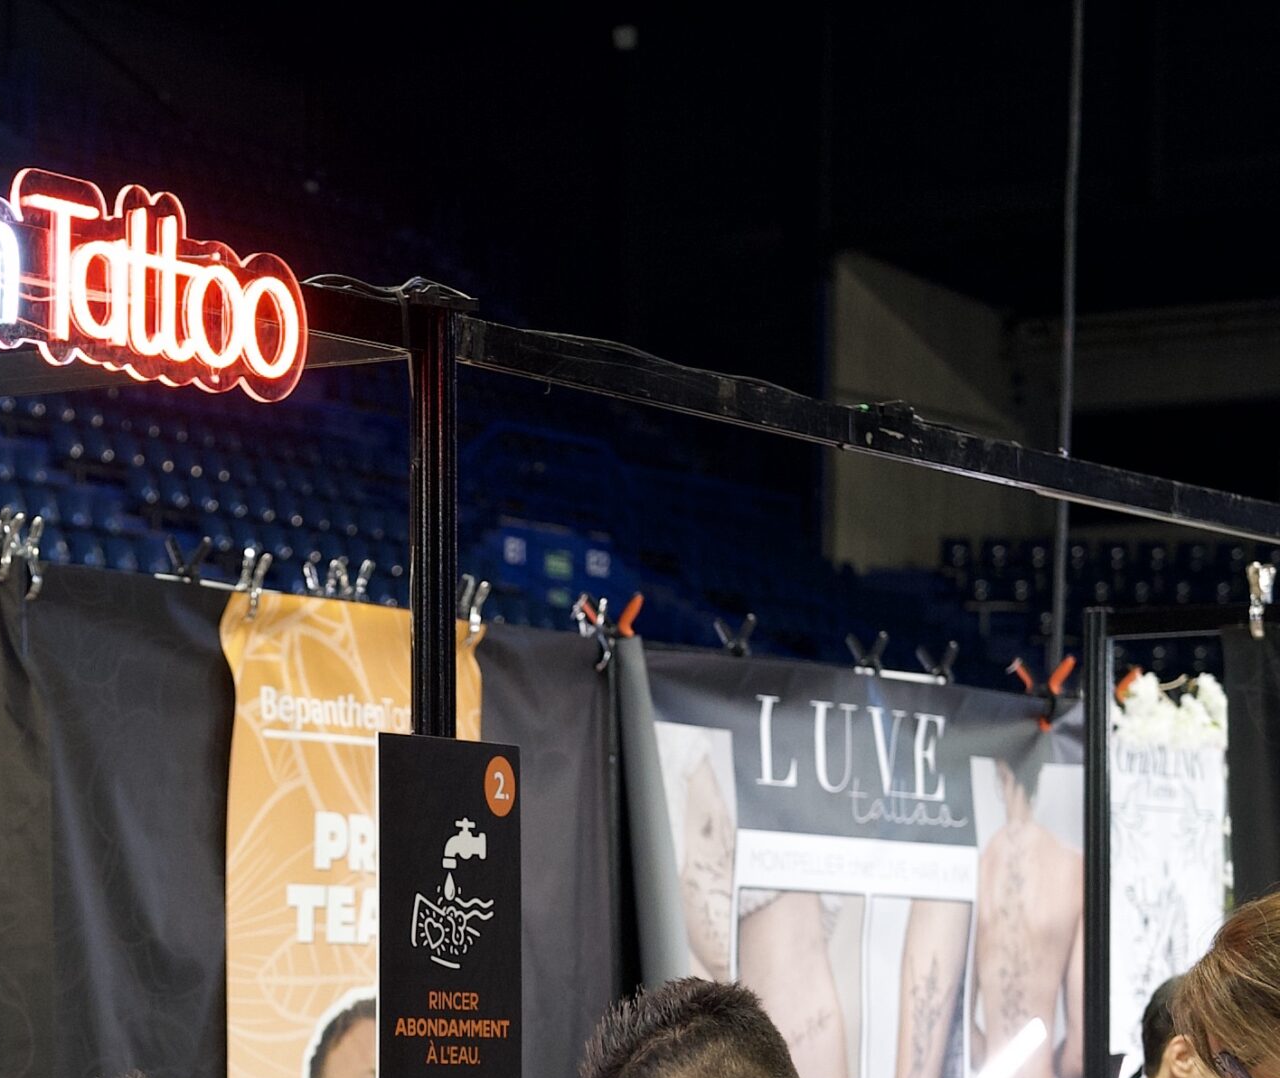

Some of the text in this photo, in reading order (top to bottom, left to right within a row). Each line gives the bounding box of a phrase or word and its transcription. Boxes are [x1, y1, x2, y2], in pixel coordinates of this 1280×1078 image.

[755, 694, 946, 801] LUVE
[493, 771, 510, 800] 2.
[314, 811, 376, 872] PR
[428, 991, 480, 1010] RINCER
[394, 1017, 510, 1038] ABONDAMMENT
[426, 1040, 481, 1065] À L'EAU.
